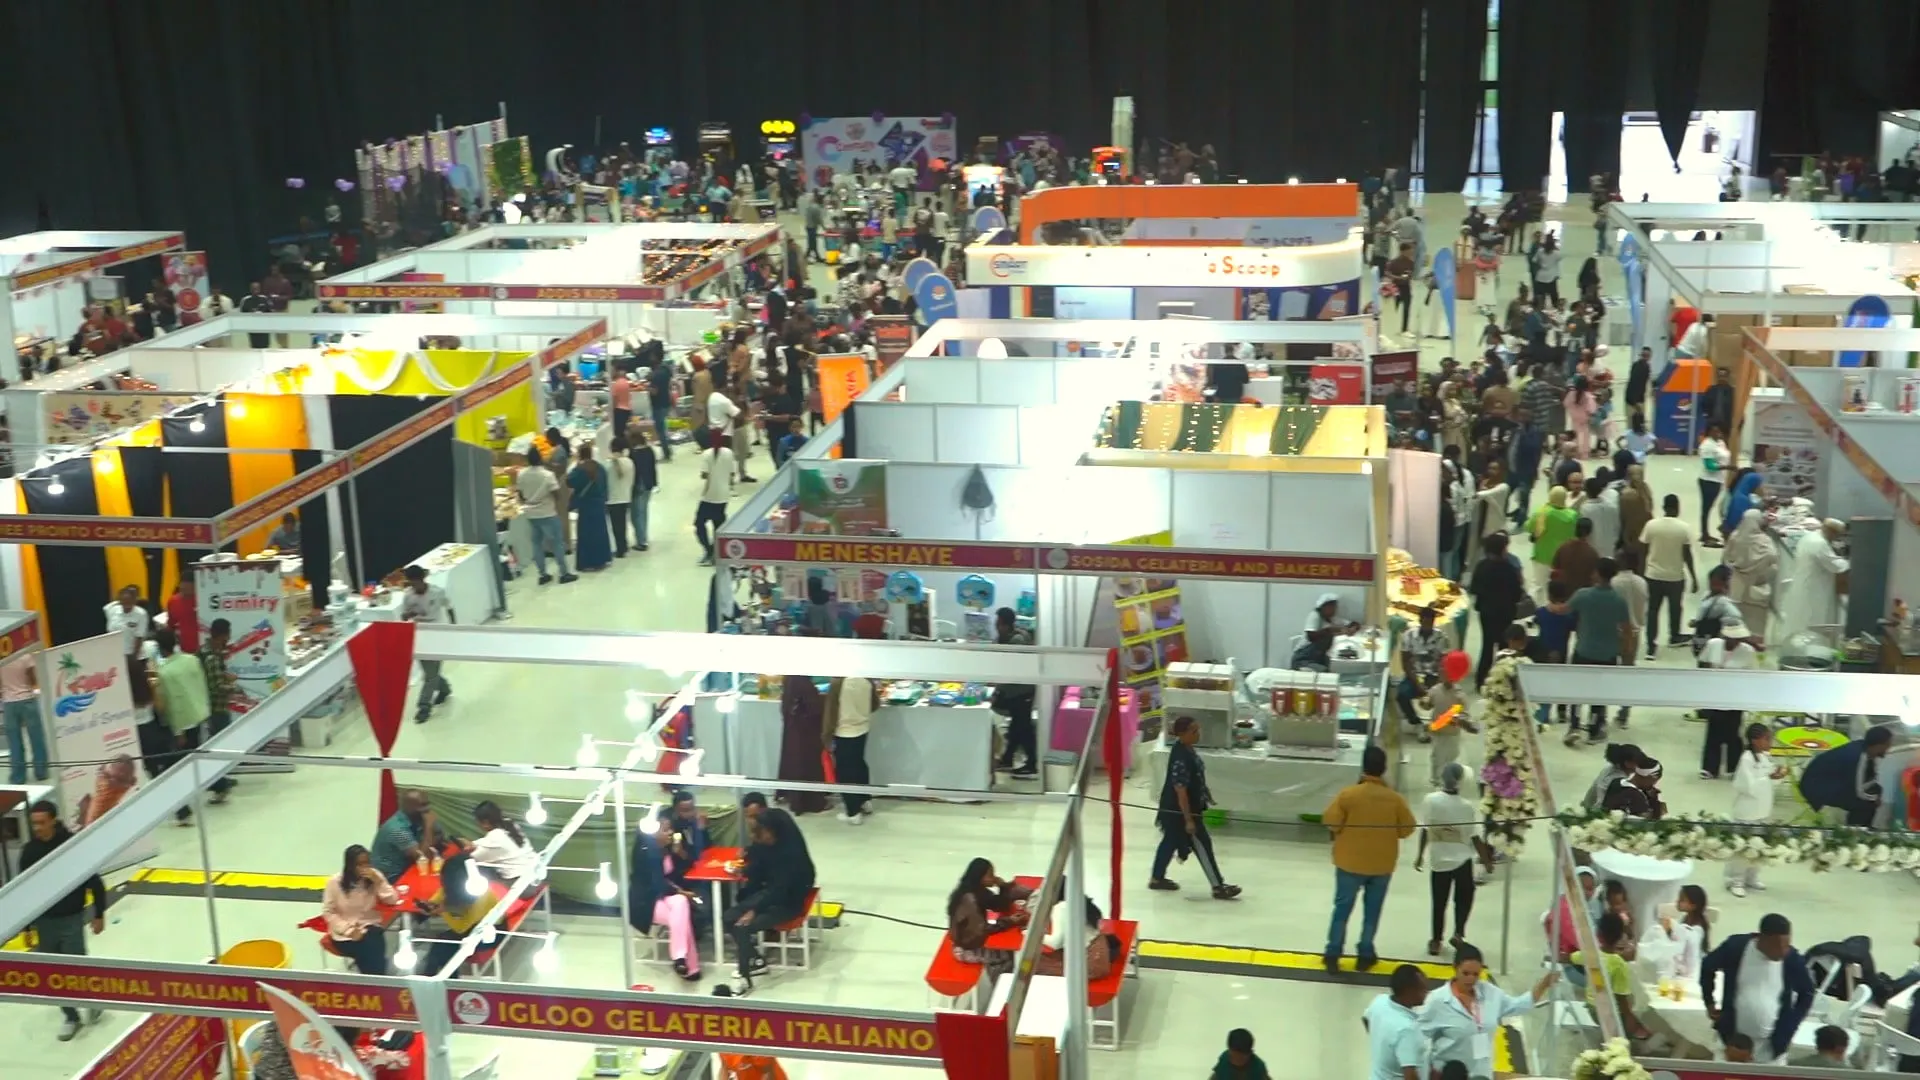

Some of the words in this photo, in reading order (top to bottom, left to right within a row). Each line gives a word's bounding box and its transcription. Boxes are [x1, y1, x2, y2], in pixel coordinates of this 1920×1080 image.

[27, 524, 90, 538] PRONTO
[93, 527, 186, 540] CHOCOLATE
[795, 542, 956, 566] MENESHAYE
[1136, 557, 1226, 572] GELATERIA
[1232, 561, 1269, 574] AND
[1273, 563, 1341, 577] BAKERY
[47, 973, 155, 996] ORIGINAL
[161, 980, 249, 1003] ITALIAN
[302, 991, 383, 1012] CREAM
[498, 1002, 594, 1028] IGLOO
[606, 1009, 776, 1042] GELATERIA
[785, 1020, 935, 1051] ITALIANO
